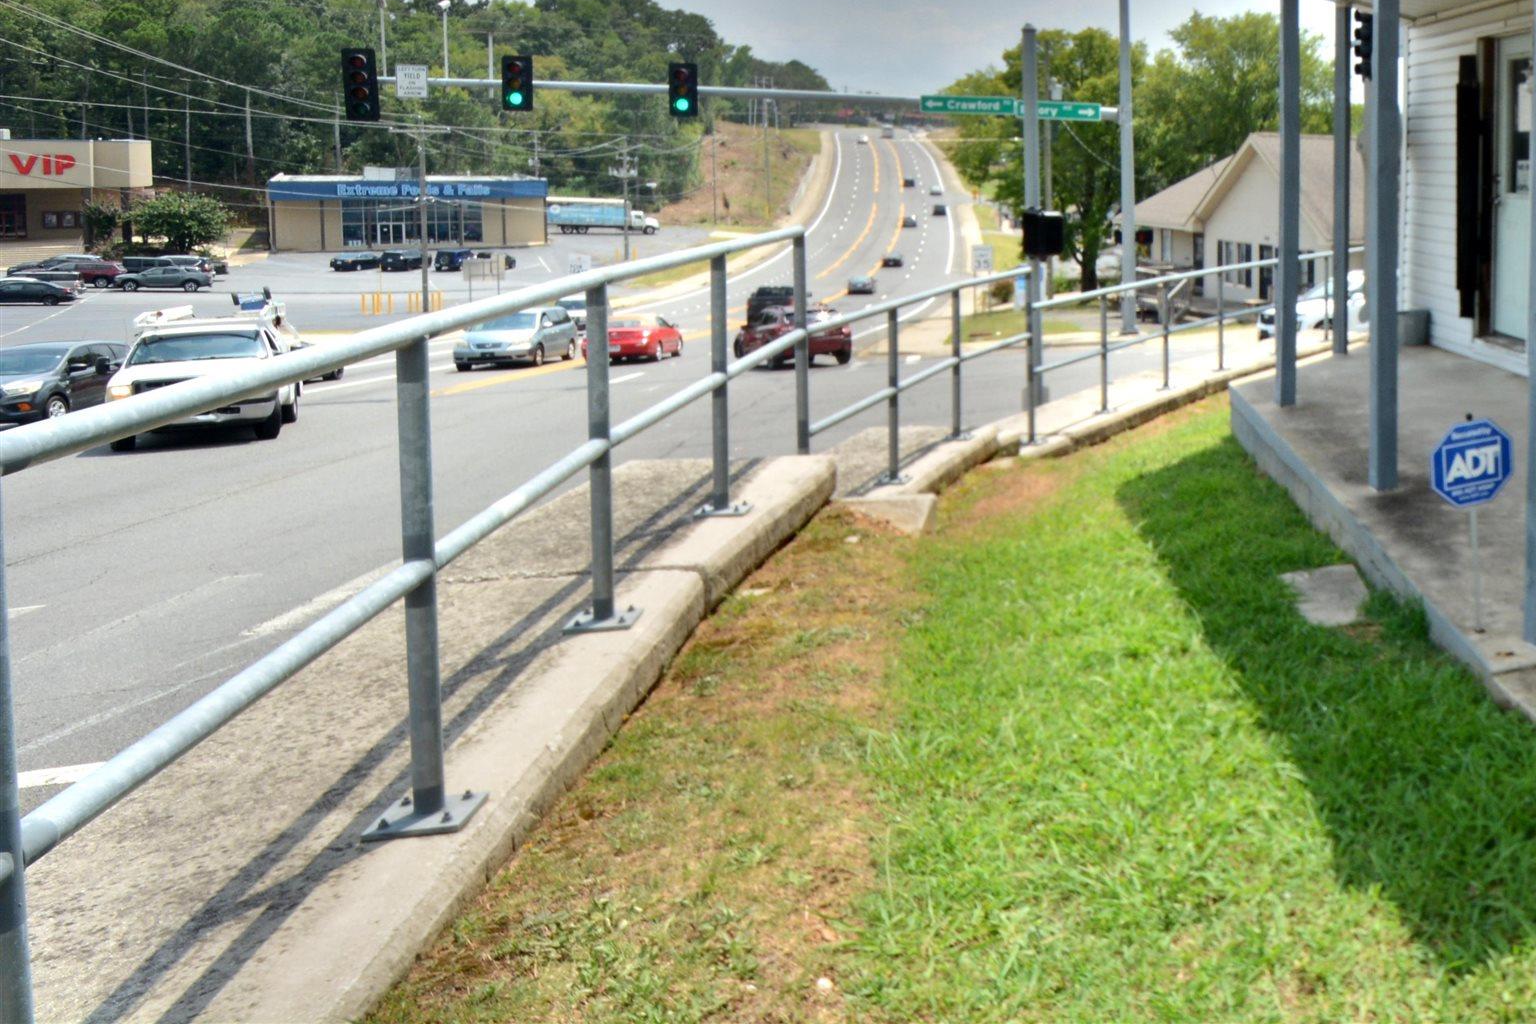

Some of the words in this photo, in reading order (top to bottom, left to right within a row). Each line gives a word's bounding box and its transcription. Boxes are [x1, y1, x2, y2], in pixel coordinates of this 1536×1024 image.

[403, 72, 421, 80] YIELD
[946, 100, 1001, 111] Crawford
[8, 154, 76, 176] VIP
[337, 183, 398, 196] Extreme
[401, 183, 440, 196] Pols
[443, 184, 455, 196] &
[457, 184, 491, 196] Falls
[1446, 443, 1501, 483] ADT
